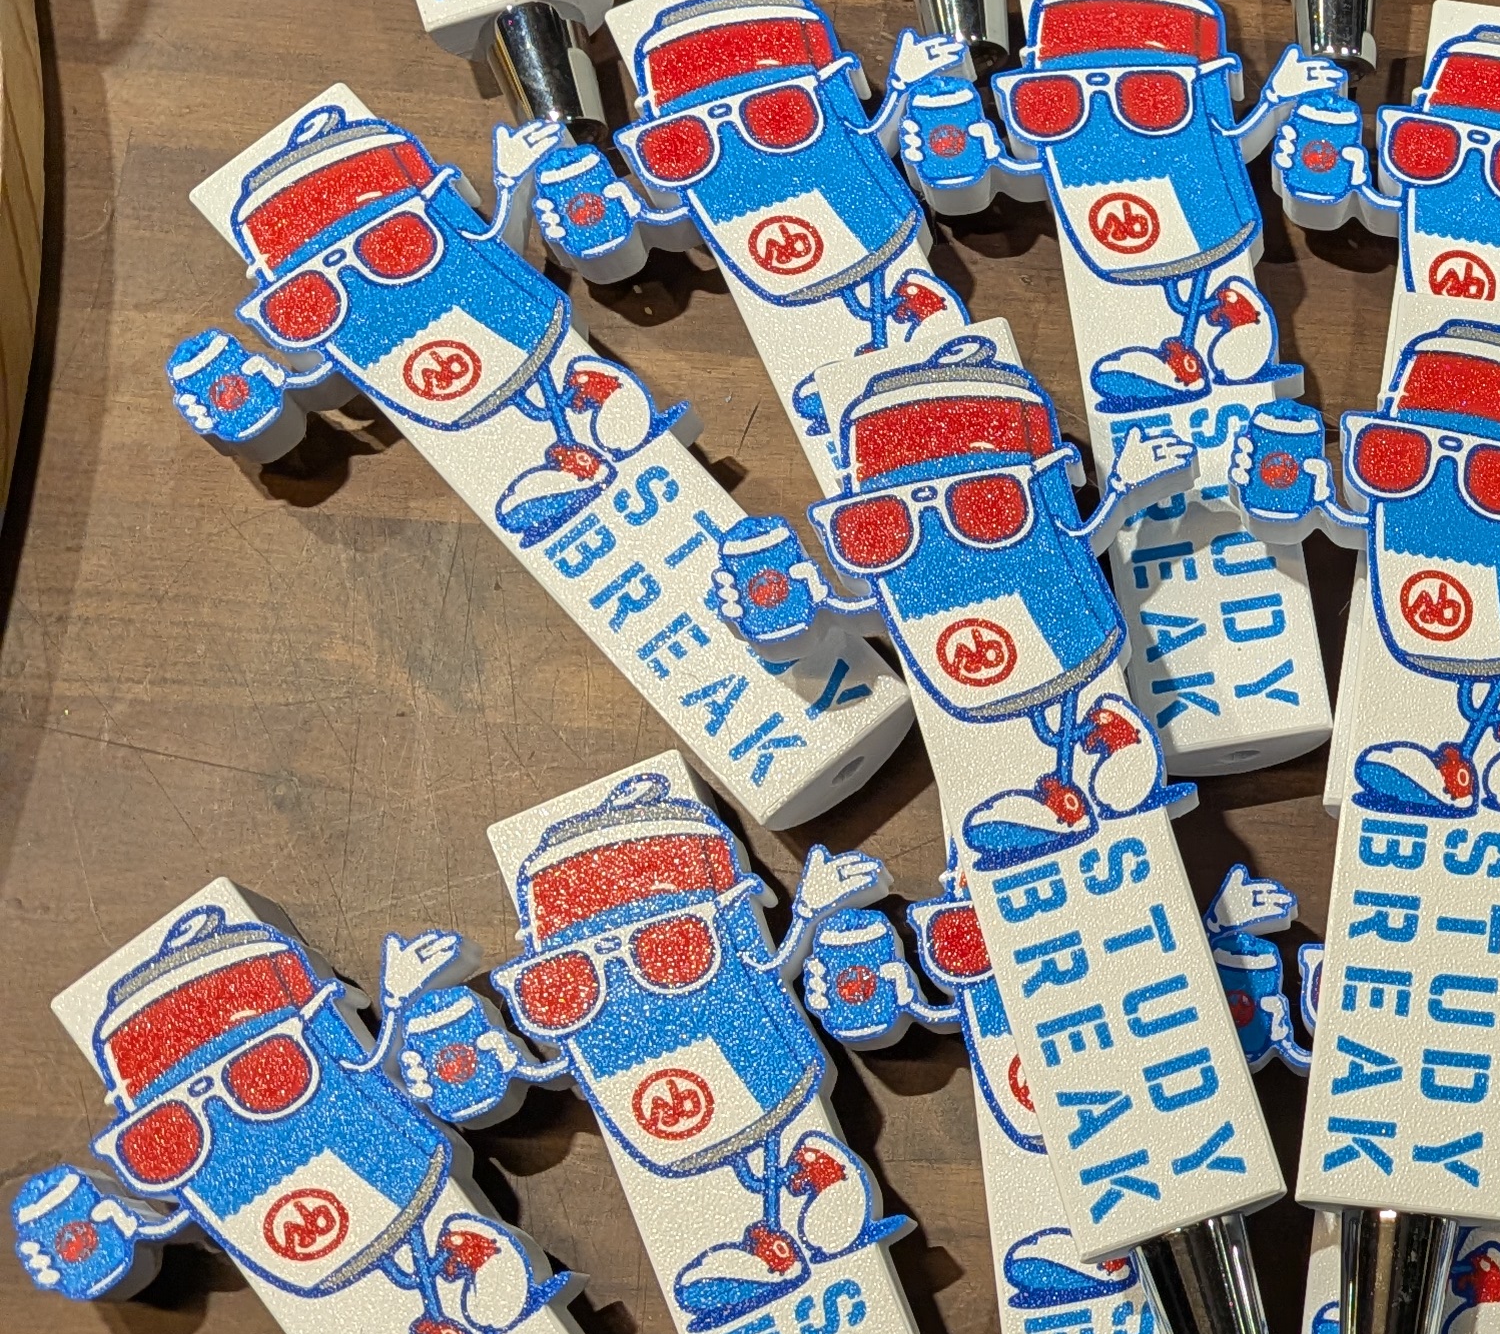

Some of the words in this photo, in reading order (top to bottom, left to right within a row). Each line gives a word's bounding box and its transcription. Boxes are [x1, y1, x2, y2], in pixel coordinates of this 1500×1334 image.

[544, 514, 806, 784] BREAK
[613, 464, 873, 720] STY
[993, 861, 1161, 1222] BREAK
[1080, 833, 1247, 1175] STUDY
[1322, 818, 1428, 1178] BREAK
